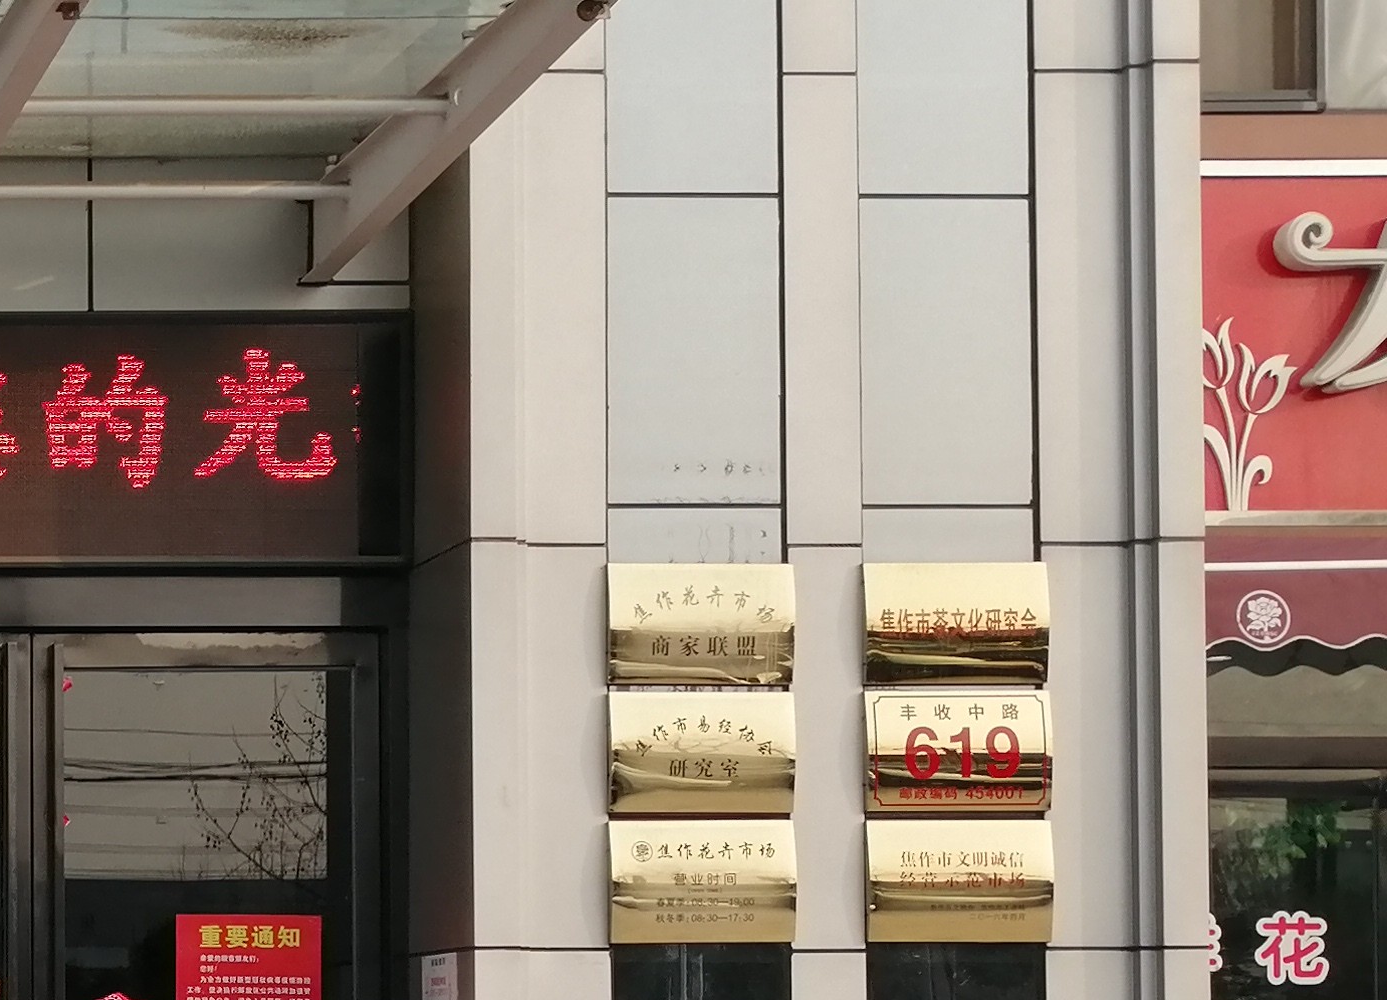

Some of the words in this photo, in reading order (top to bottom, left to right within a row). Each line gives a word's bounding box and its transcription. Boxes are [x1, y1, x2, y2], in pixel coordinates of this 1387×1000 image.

[633, 584, 776, 625] 焦作花卉市场
[651, 634, 757, 657] 商家联盟
[900, 703, 1020, 721] 丰收中路
[905, 725, 1021, 780] 619
[668, 758, 741, 779] 研究室
[899, 787, 958, 800] 邮政编码
[657, 842, 777, 860] 焦作花卉市场
[900, 851, 1025, 869] 焦作市文明诚信
[673, 872, 738, 887] 营业时间
[899, 871, 1025, 889] 经营示范市场
[199, 925, 300, 949] 重要通知
